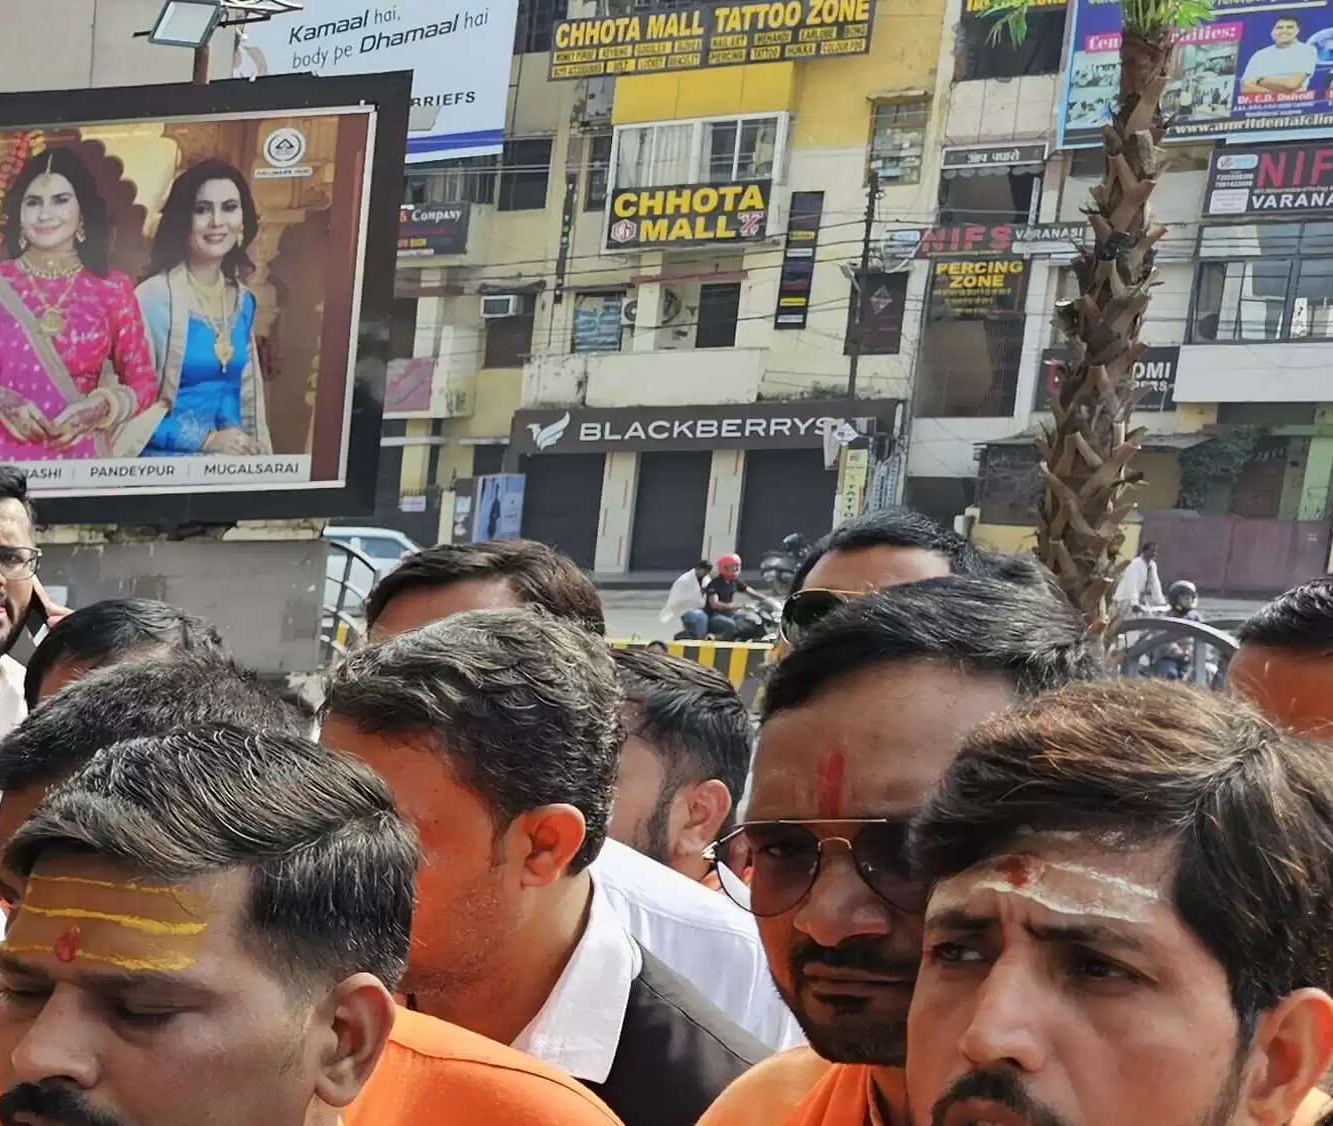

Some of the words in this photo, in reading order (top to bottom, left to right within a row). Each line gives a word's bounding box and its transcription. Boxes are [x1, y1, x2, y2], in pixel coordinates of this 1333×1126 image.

[289, 10, 370, 45] Kamaal
[556, 16, 641, 48] CHHOTA
[646, 10, 704, 40] MALL
[715, 2, 802, 33] TATTOO
[806, 0, 870, 25] ZONE
[293, 48, 328, 70] body
[334, 43, 353, 65] pe
[359, 14, 459, 54] Dhamaal
[464, 9, 489, 30] hai
[613, 184, 765, 218] CHHOTA
[639, 215, 737, 242] MALL
[921, 224, 1013, 253] NIFS
[936, 261, 1023, 275] PERCING
[949, 275, 1004, 288] ZONE
[579, 417, 831, 440] BLACKBERRYS
[90, 464, 175, 478] PANDEYPUR
[204, 462, 300, 476] MUGALSARAI
